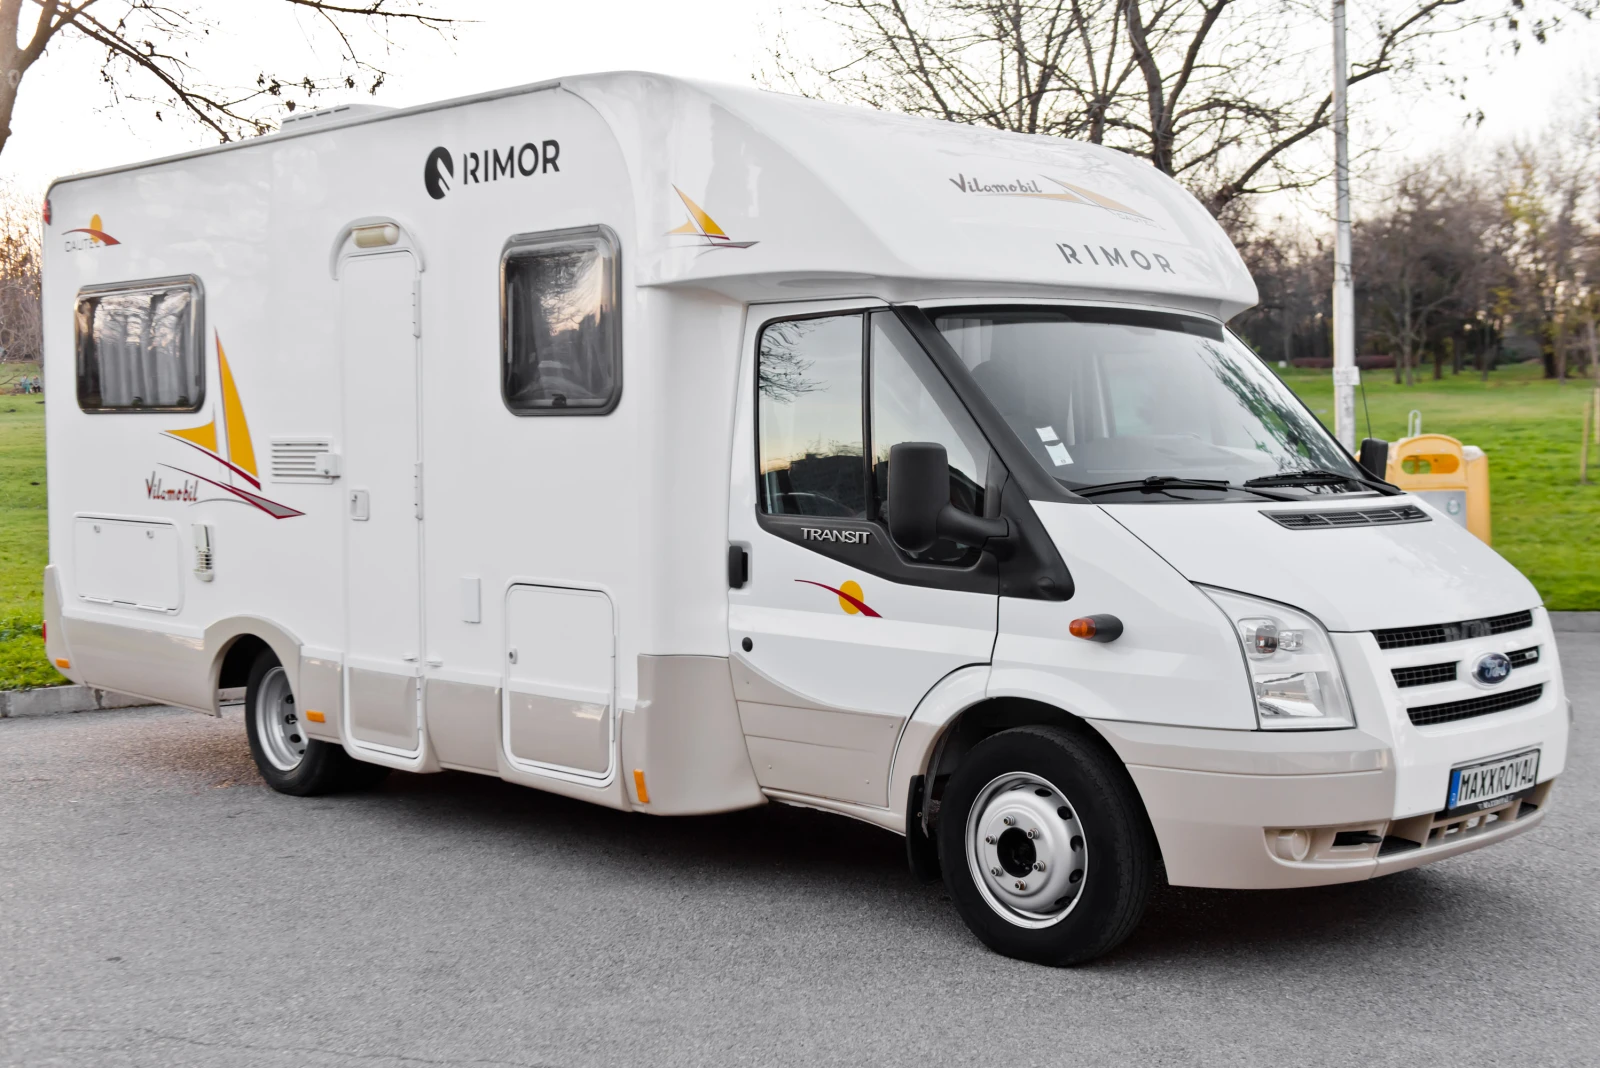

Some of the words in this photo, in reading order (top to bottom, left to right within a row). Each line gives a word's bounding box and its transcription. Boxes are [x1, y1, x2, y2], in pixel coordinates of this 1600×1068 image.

[463, 139, 560, 185] RIMOR
[948, 173, 1042, 193] Vilamobil
[1055, 243, 1176, 274] RIMOR
[145, 471, 198, 502] Vilamobil
[801, 527, 870, 544] TRANSIT
[1458, 758, 1535, 801] MAXXROYAL
